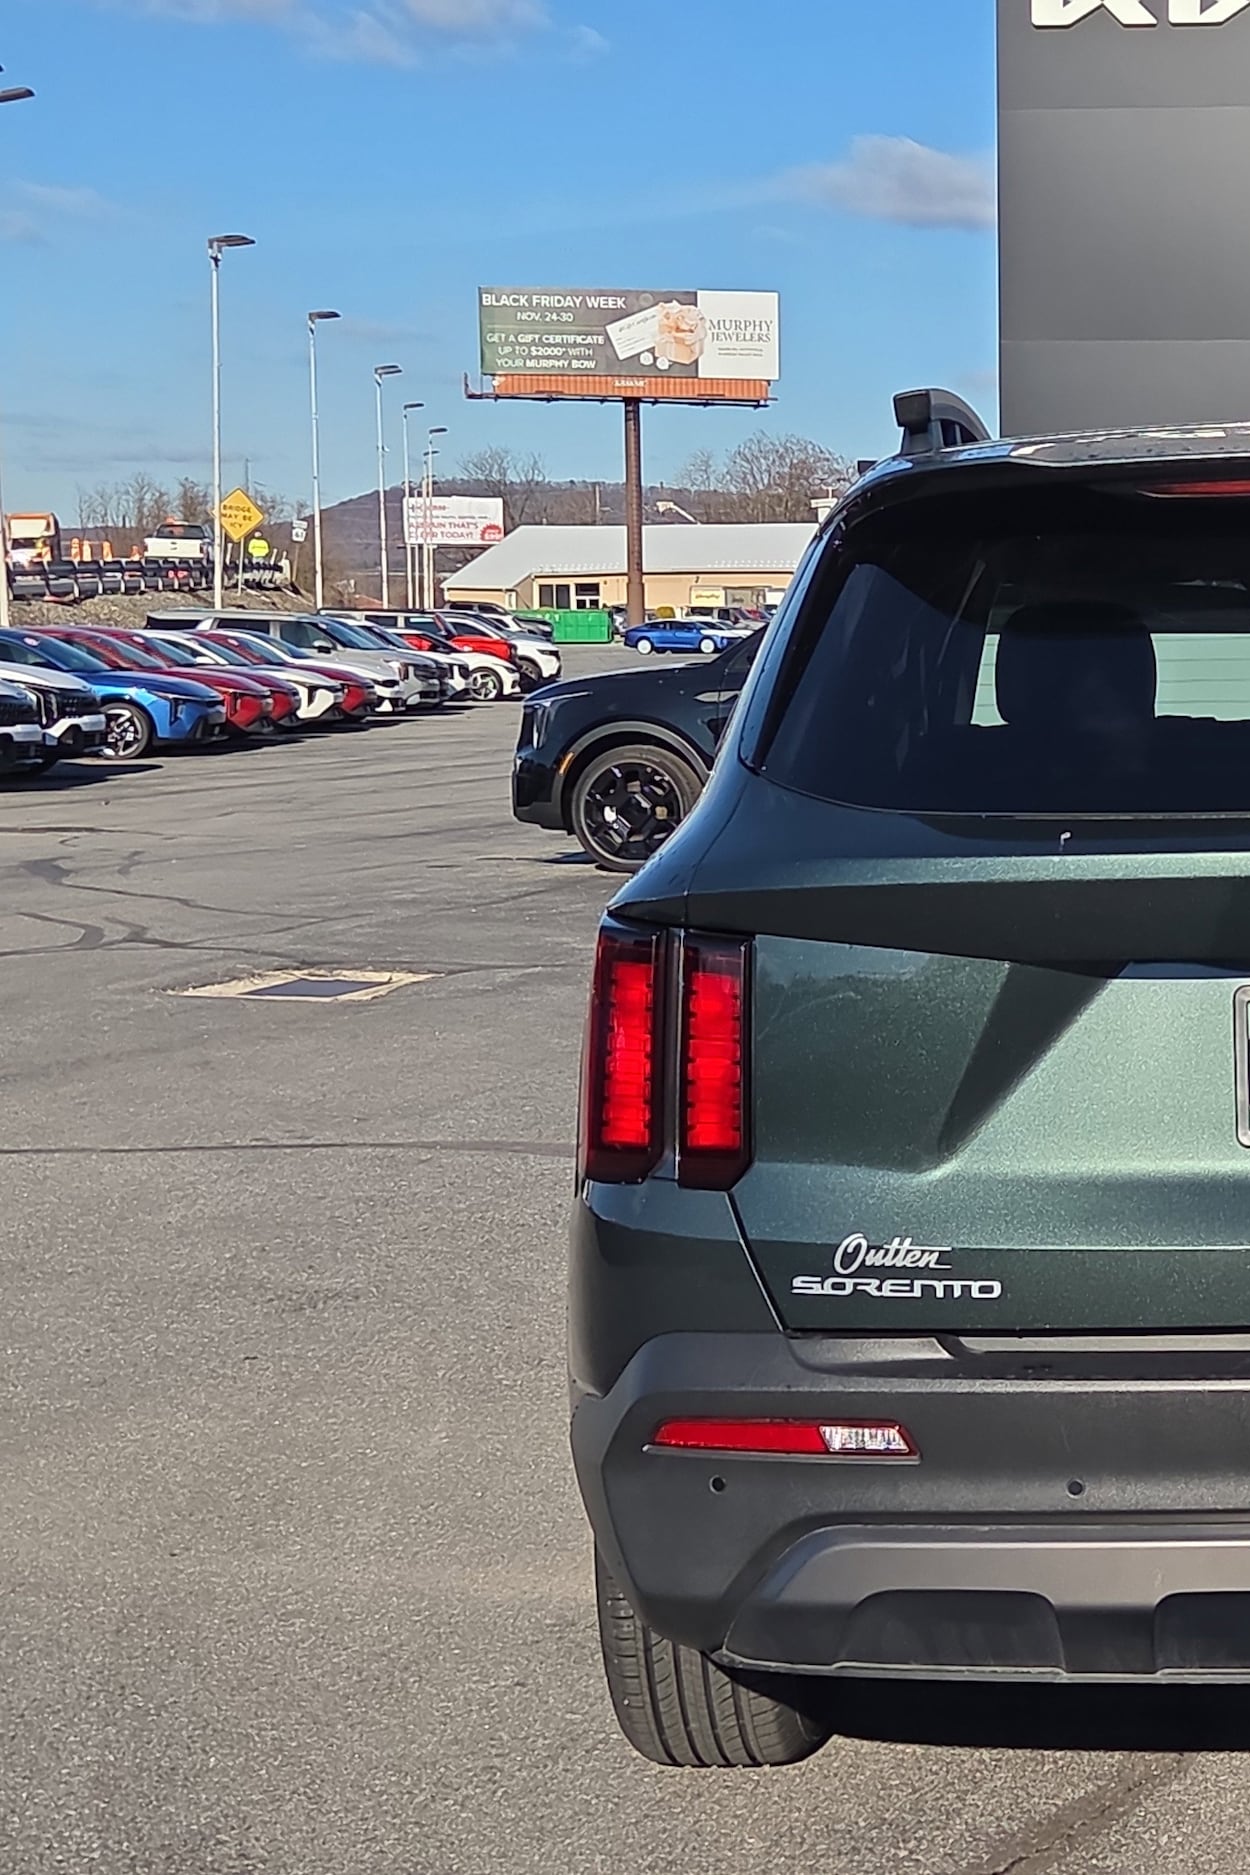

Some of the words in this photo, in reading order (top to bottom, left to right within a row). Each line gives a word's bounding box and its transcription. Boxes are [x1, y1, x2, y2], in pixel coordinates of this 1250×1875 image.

[482, 293, 529, 307] BLACK
[532, 294, 583, 308] FRIDAY
[586, 296, 626, 309] WEEK
[517, 311, 541, 321] NOV.
[544, 312, 573, 322] 24-30
[709, 319, 773, 332] MURPHY
[486, 333, 506, 343] GET
[508, 334, 515, 343] A
[517, 334, 539, 344] GIFT
[539, 334, 604, 345] CERTIFICATE
[711, 331, 771, 343] JEWELERS
[498, 346, 513, 355] UP
[515, 347, 528, 355] TO
[568, 347, 593, 356] WITH
[496, 358, 524, 368] YOUR
[526, 359, 570, 369] MURPHY
[571, 359, 596, 369] BOW
[222, 504, 252, 513] BRIDGE
[833, 1232, 952, 1275] Outten
[791, 1276, 1002, 1299] SORENTO
